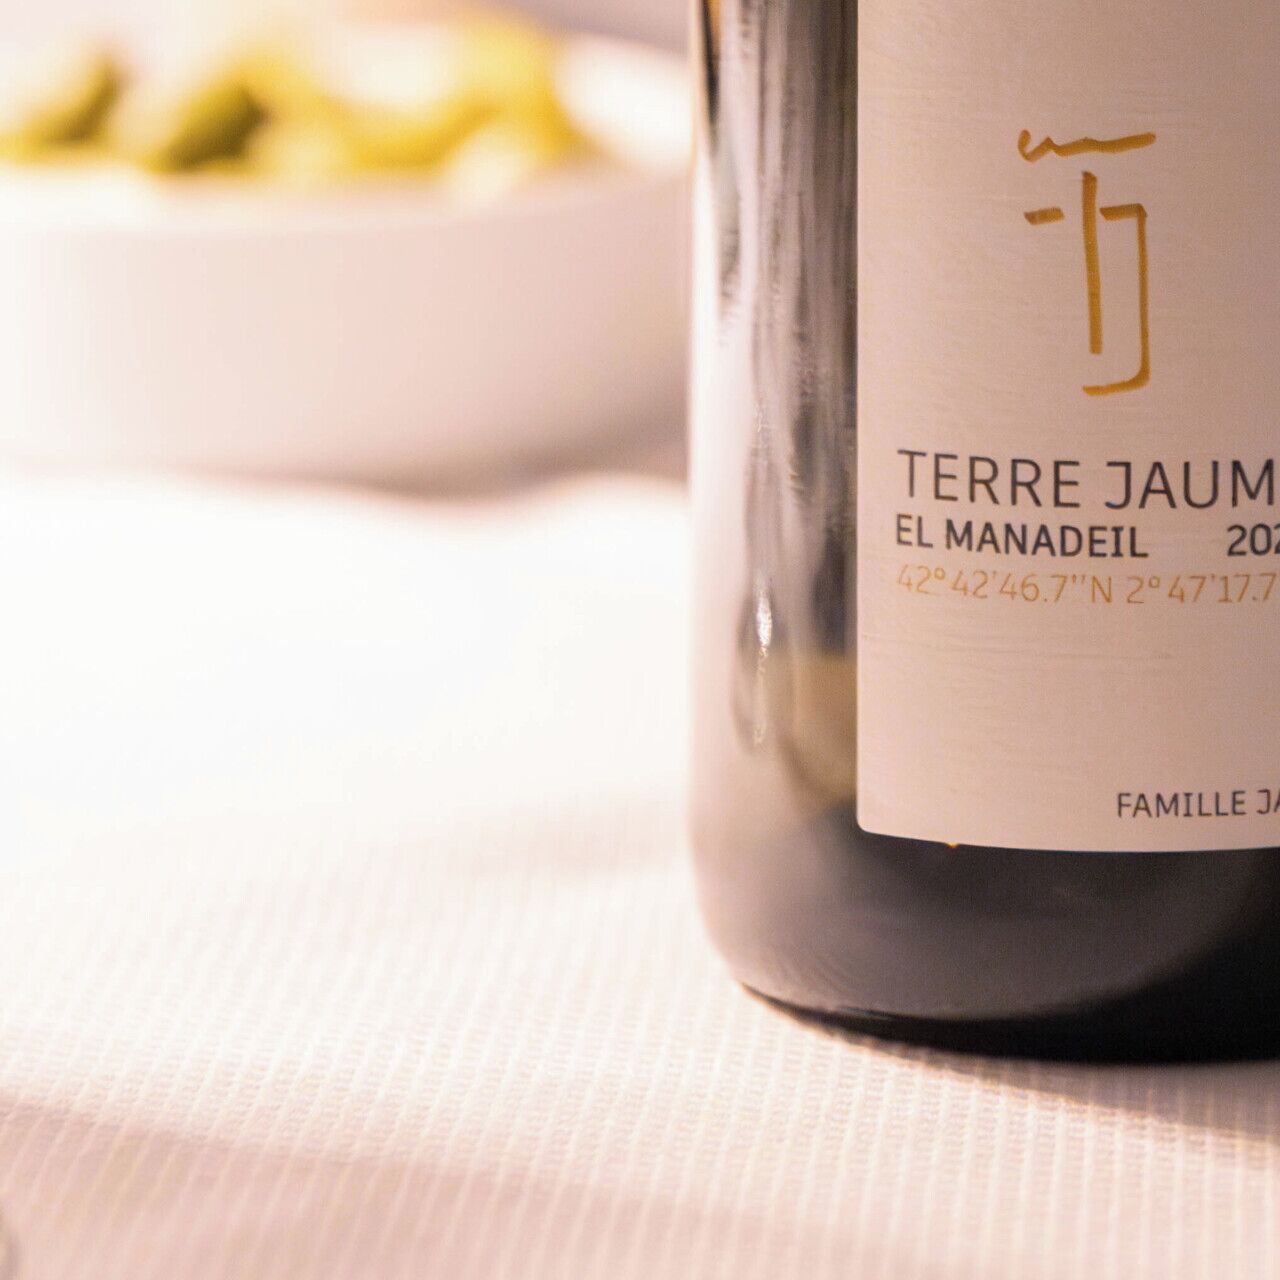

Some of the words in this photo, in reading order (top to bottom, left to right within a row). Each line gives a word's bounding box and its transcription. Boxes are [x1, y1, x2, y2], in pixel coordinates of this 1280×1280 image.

[897, 449, 1081, 509] TERRE
[896, 513, 933, 548] EL
[945, 519, 1149, 558] MANADEIL
[1117, 791, 1247, 818] FAMILLE
